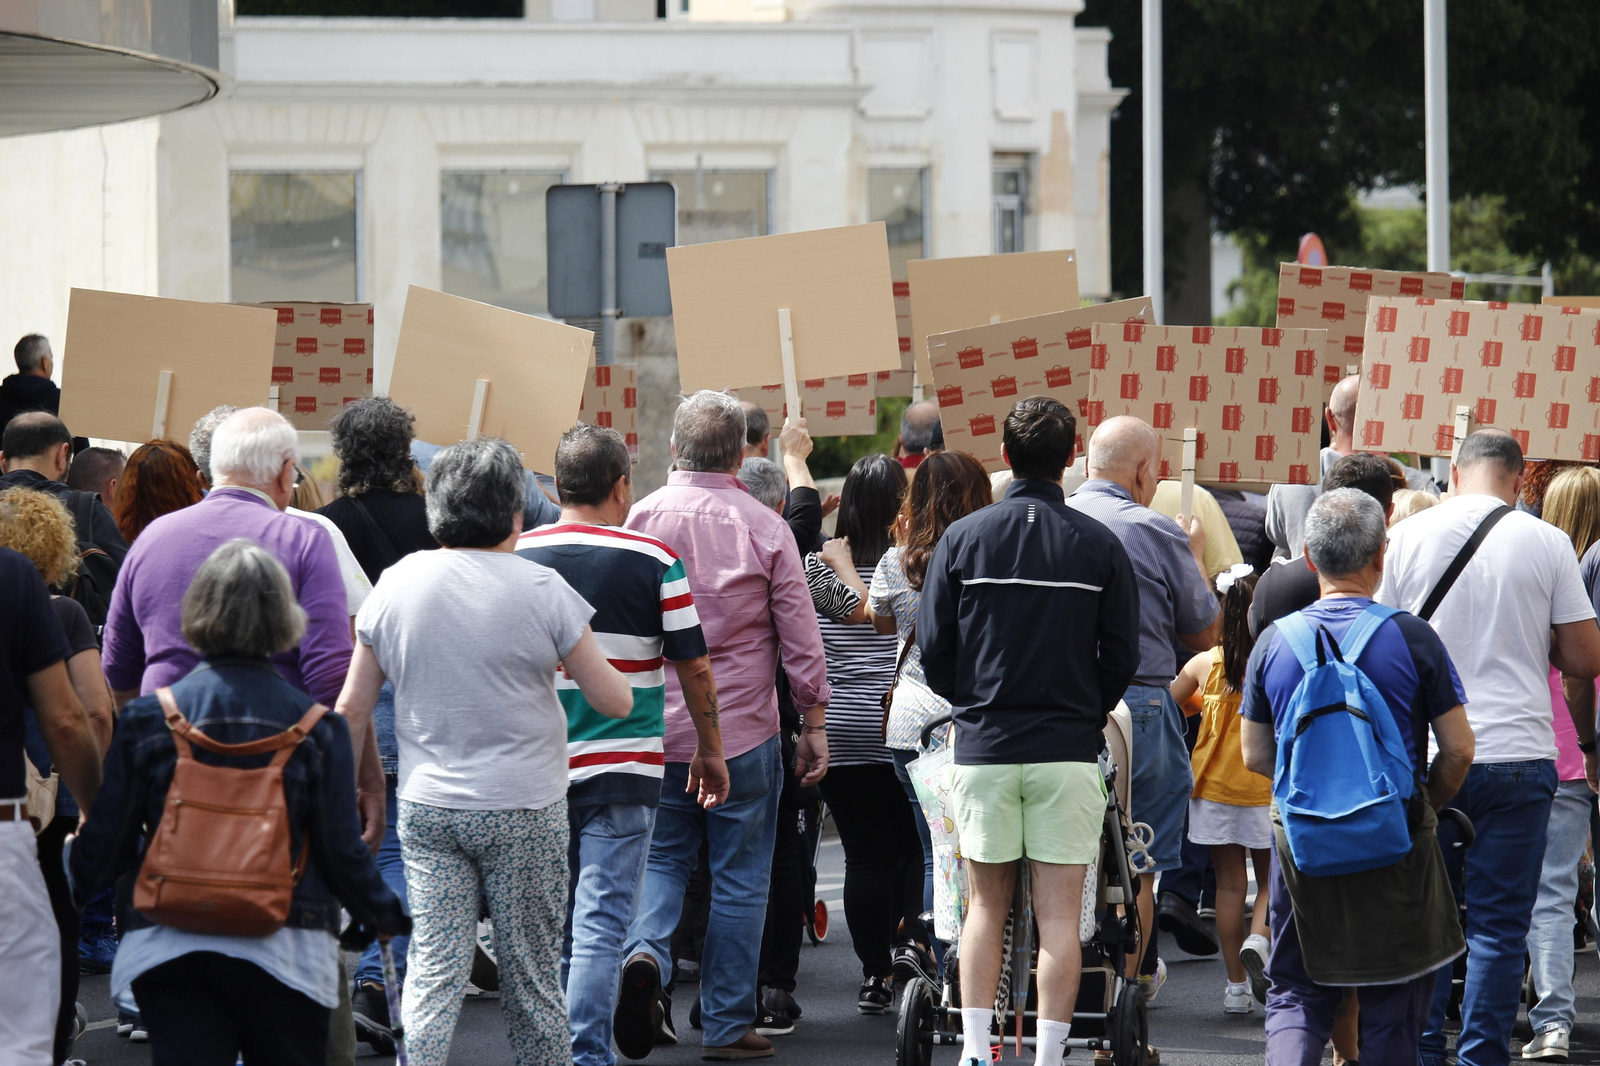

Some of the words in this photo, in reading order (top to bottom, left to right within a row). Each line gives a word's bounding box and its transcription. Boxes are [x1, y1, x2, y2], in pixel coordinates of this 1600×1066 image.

[1069, 335, 1090, 344] pujadas
[1015, 345, 1036, 354] pujadas
[961, 354, 982, 363] pujadas
[1048, 373, 1069, 382] pujadas
[994, 382, 1015, 392] pujadas
[940, 393, 961, 402] pujadas
[972, 421, 994, 431] pujadas
